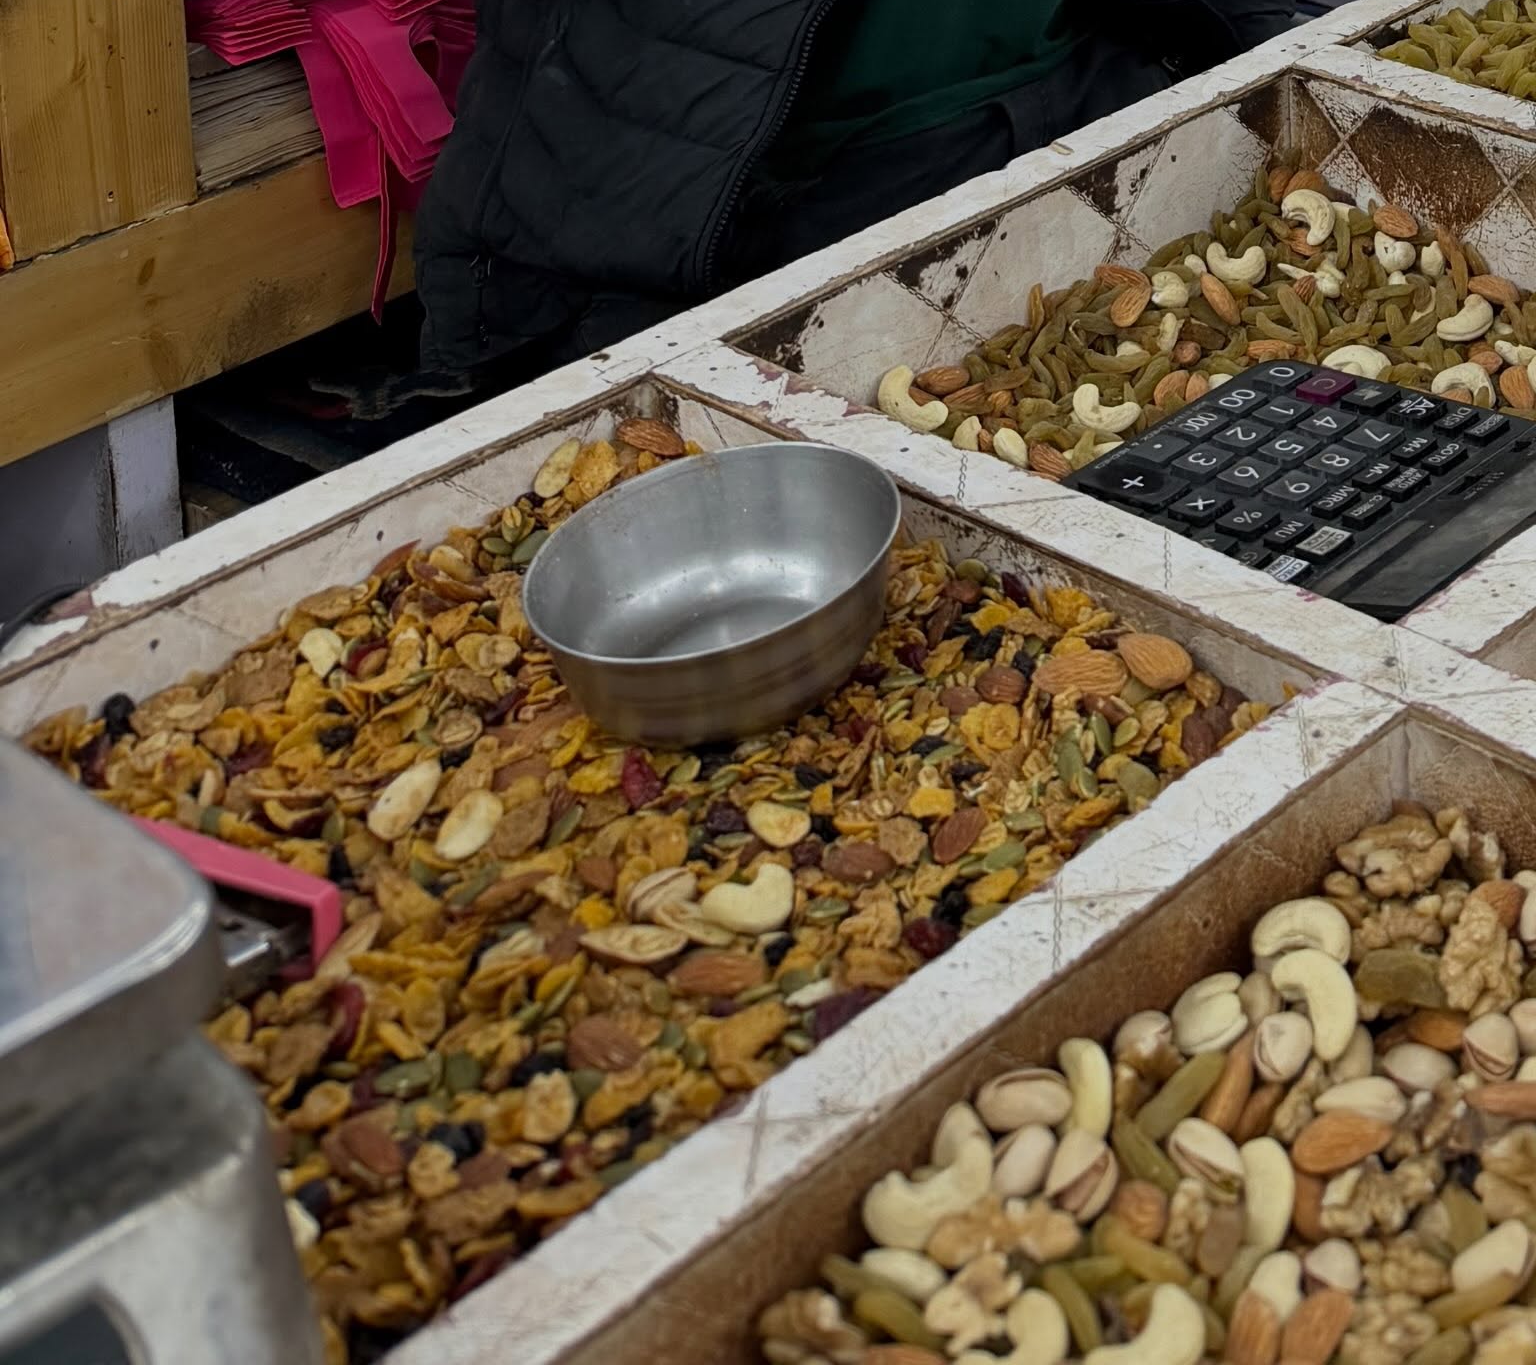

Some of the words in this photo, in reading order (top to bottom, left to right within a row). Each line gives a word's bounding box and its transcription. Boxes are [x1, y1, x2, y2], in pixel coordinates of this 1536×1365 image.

[1269, 367, 1295, 377] 0
[1311, 378, 1337, 391] C
[1218, 389, 1256, 407] 00
[1269, 405, 1294, 416] 1
[1405, 398, 1435, 417] AC
[1313, 415, 1337, 429] 4
[1226, 426, 1257, 441] 2
[1364, 428, 1391, 442] 7
[1274, 439, 1304, 454] 5
[1402, 437, 1428, 453] M+
[1188, 452, 1217, 466] 3
[1321, 453, 1350, 466] 8
[1428, 443, 1459, 464] GOTO
[1234, 466, 1260, 479] 6
[1285, 479, 1310, 493] 9
[1318, 485, 1355, 509] MRC
[1274, 520, 1304, 538] MU
